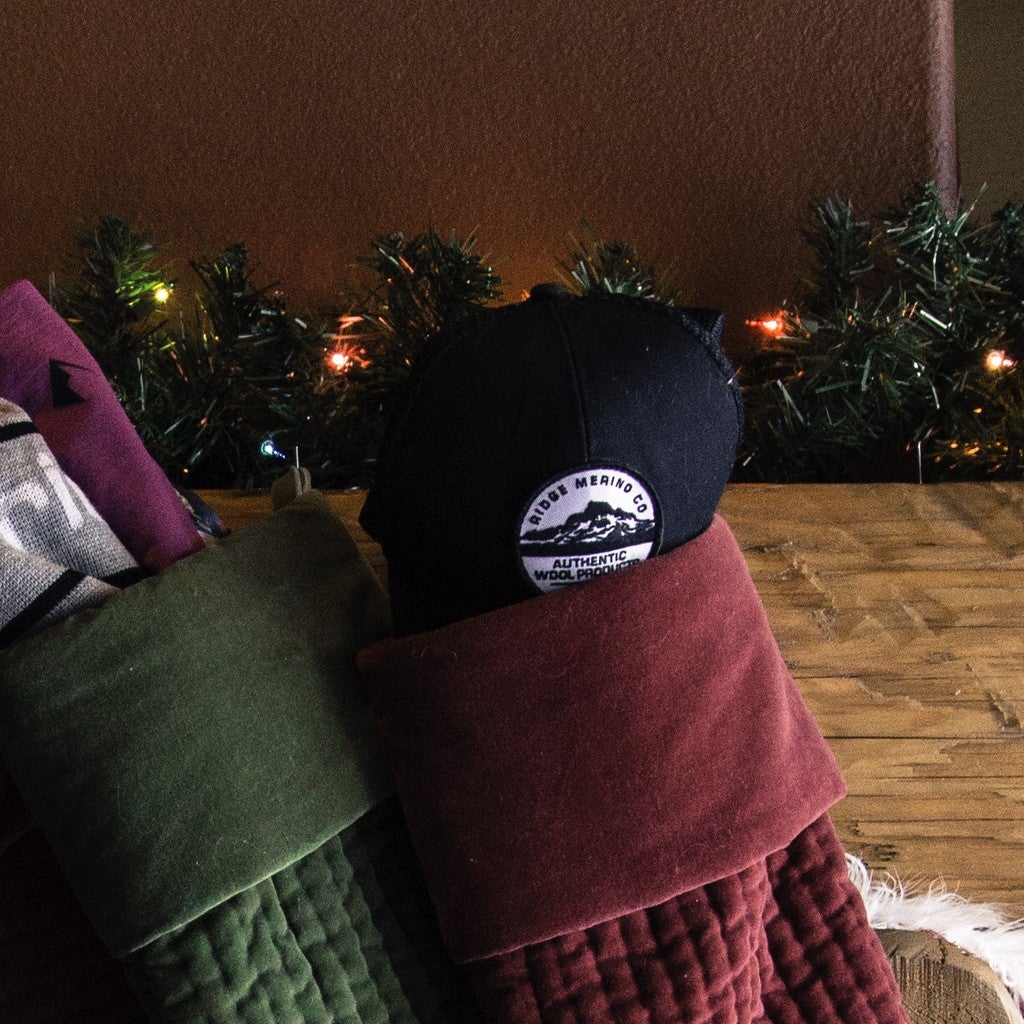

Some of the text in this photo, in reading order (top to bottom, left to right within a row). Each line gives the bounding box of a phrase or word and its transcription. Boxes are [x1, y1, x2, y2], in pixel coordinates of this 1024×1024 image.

[529, 475, 649, 526] RIDGE MERINO CO
[552, 550, 628, 569] AUTHENTIC
[534, 569, 576, 581] WOOL
